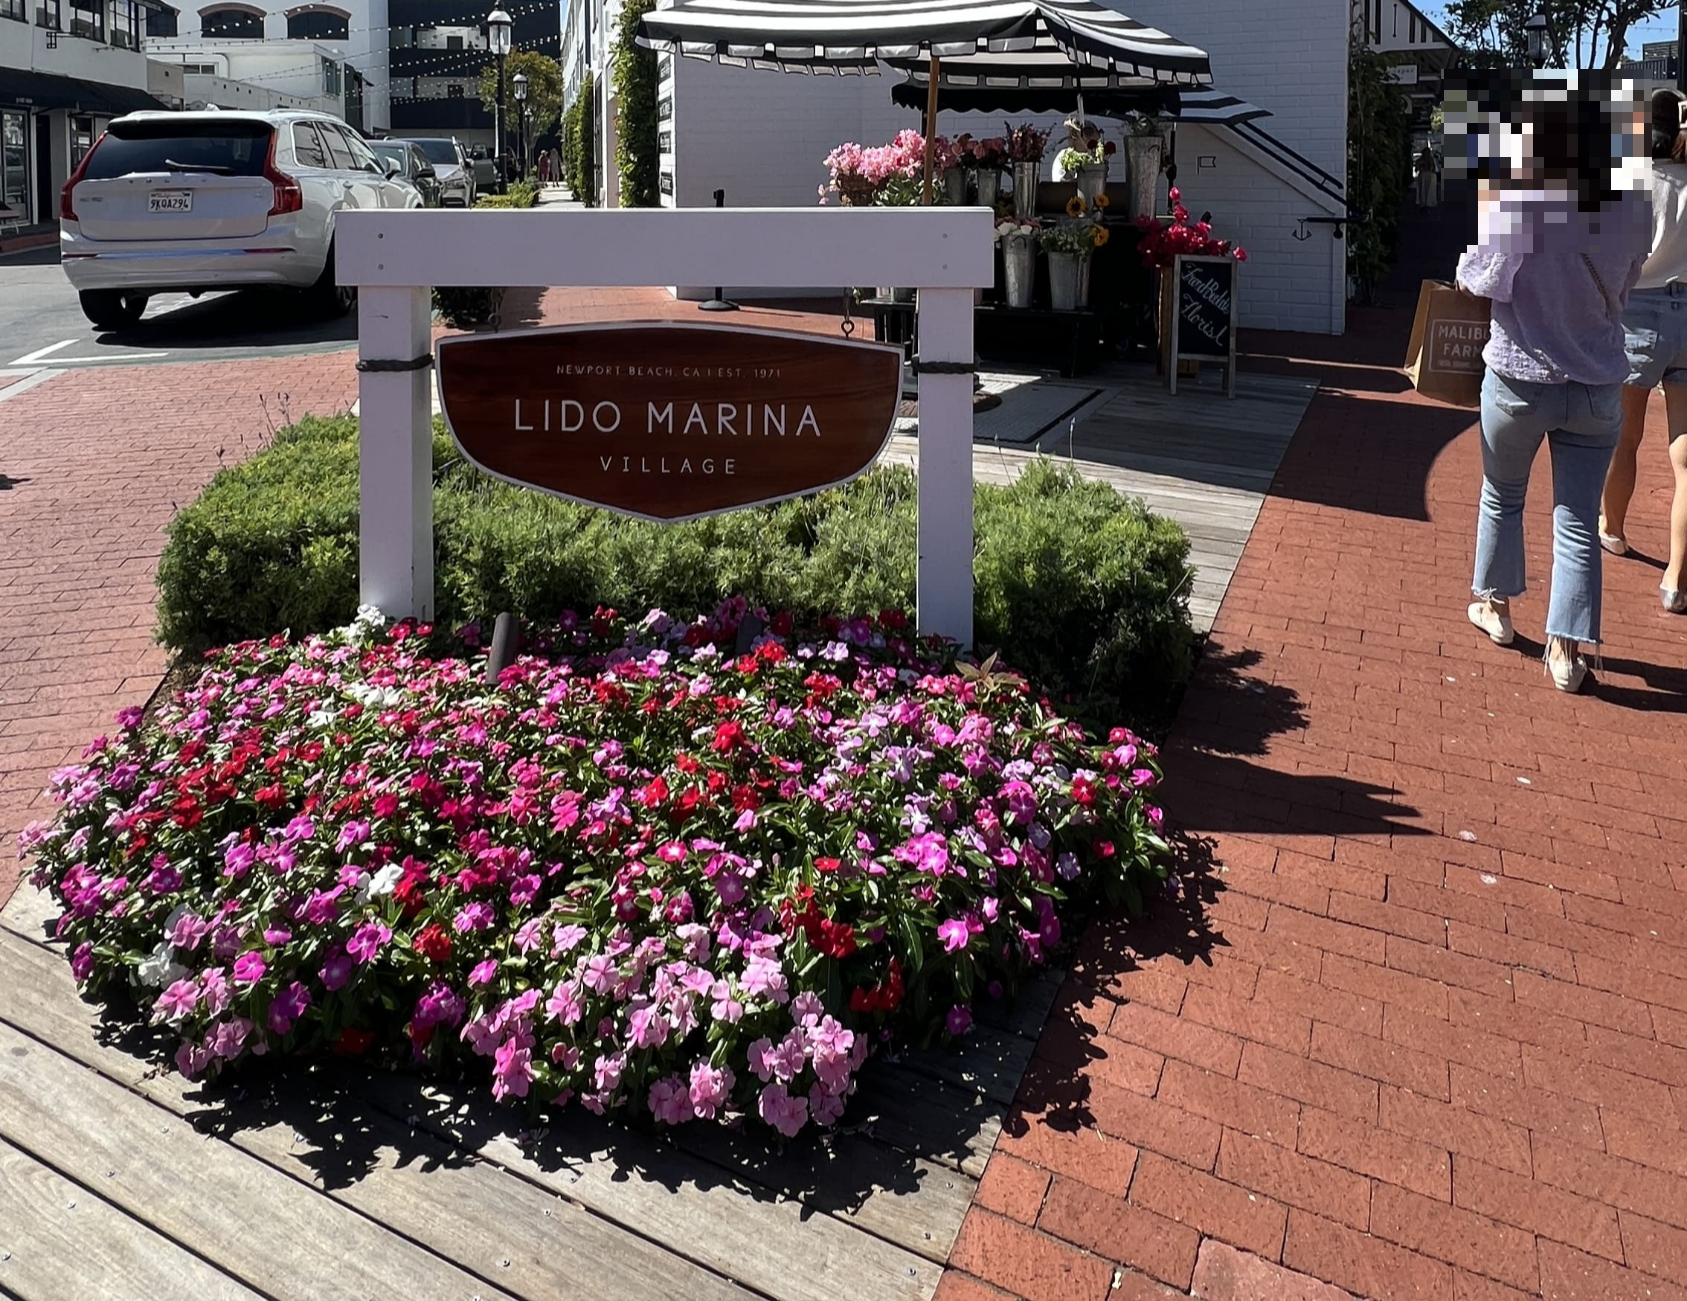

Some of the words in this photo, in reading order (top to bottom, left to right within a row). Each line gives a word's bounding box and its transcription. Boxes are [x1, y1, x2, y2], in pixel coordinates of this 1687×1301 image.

[556, 364, 621, 375] NEWPORT
[683, 366, 700, 377] CA
[754, 368, 781, 378] 1971
[515, 398, 621, 432] LIDO
[647, 401, 822, 437] MARINA
[599, 455, 736, 475] VILLAGE
